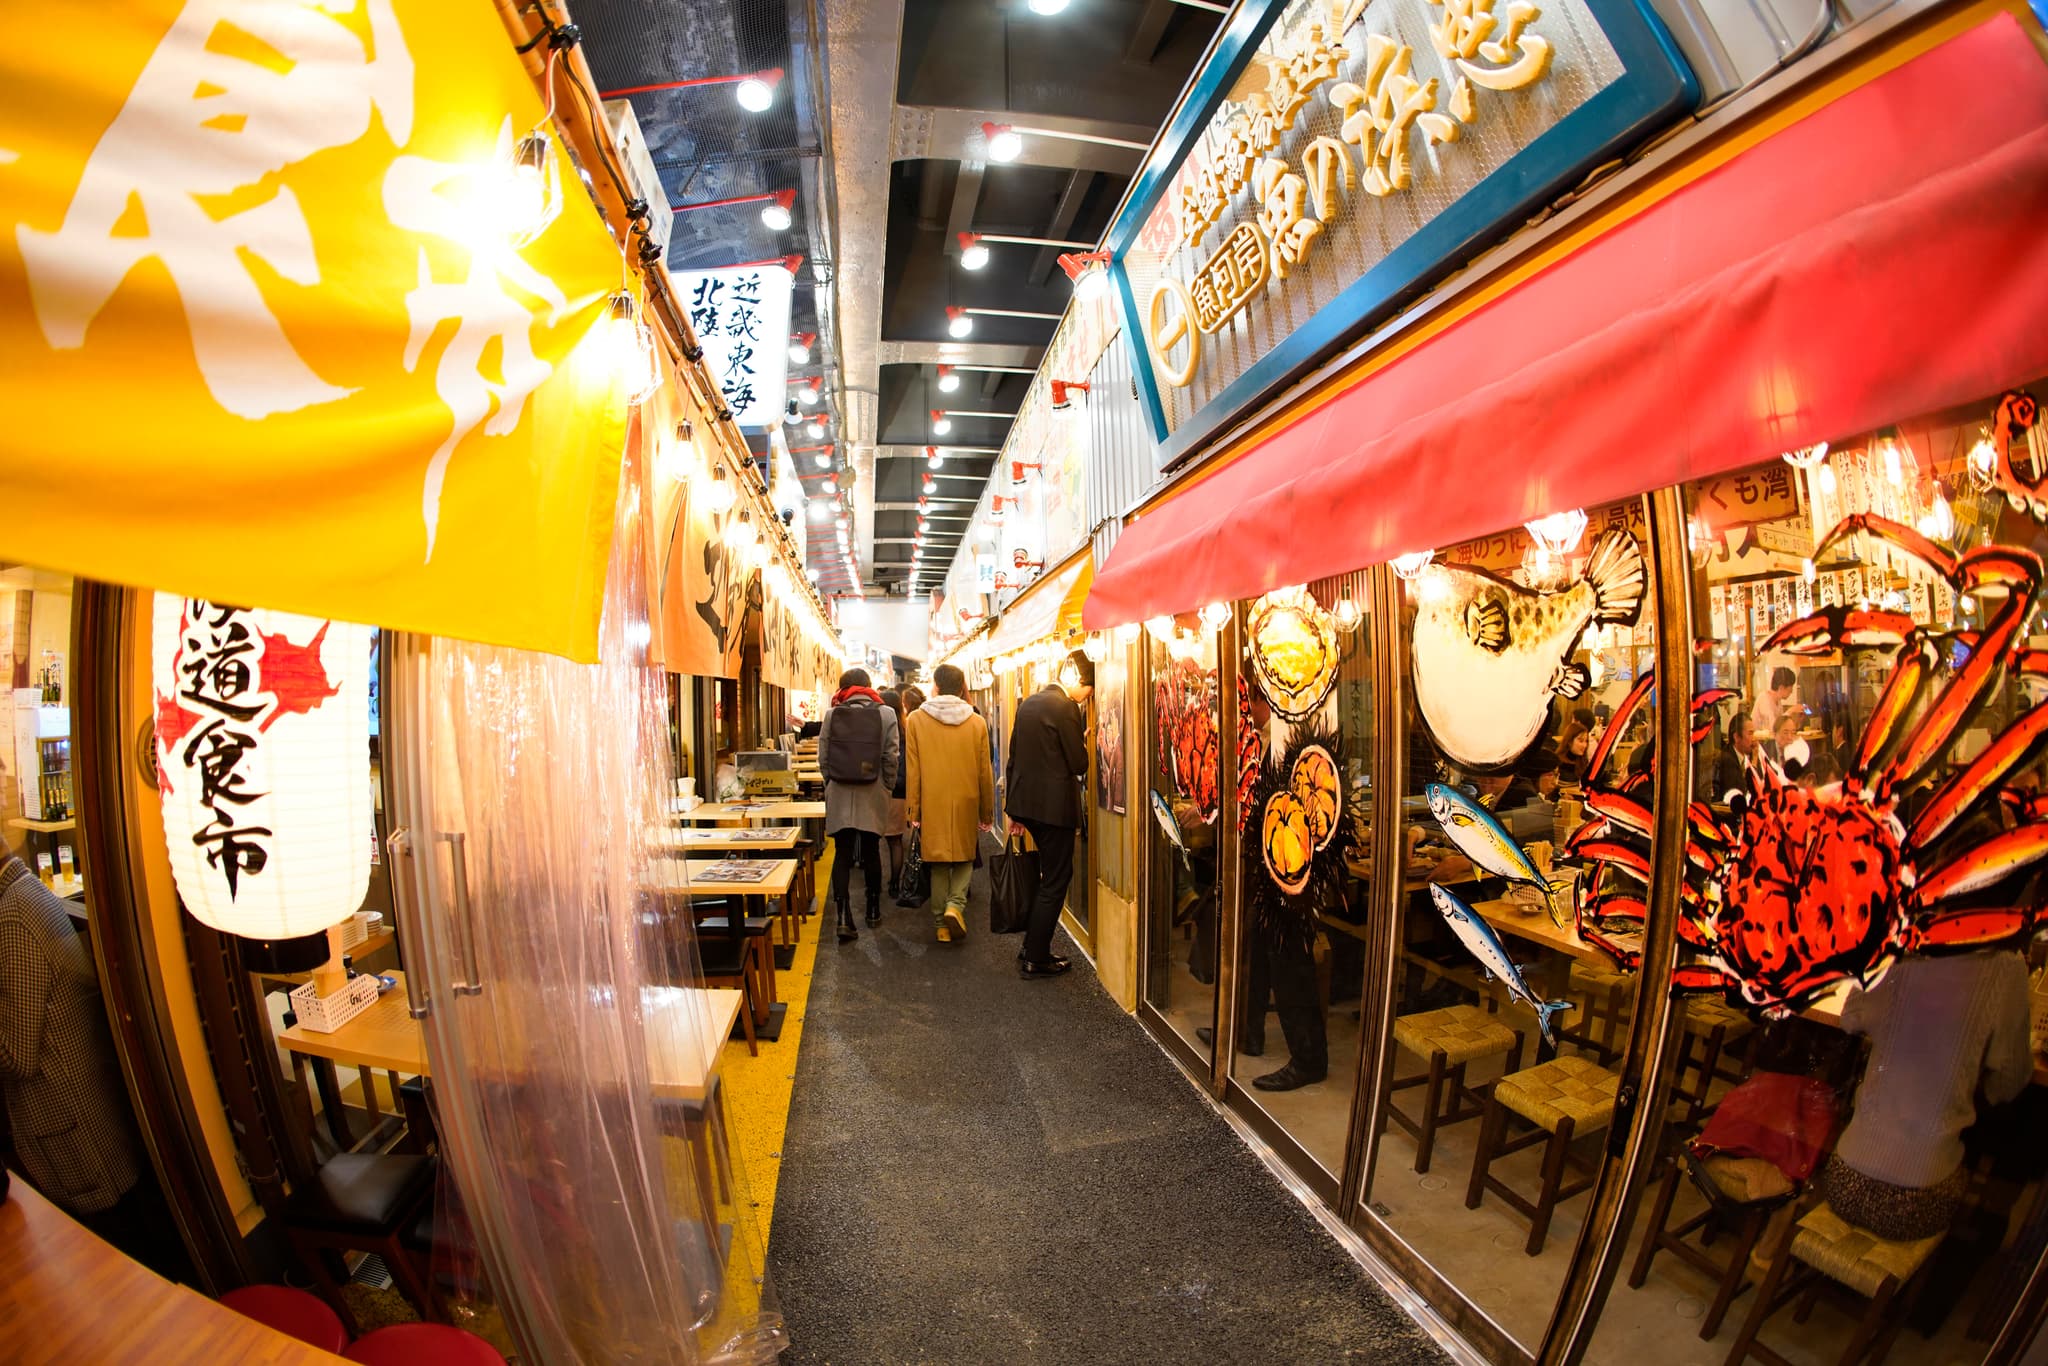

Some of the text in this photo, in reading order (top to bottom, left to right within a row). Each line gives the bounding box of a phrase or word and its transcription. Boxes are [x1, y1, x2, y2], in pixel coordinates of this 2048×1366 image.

[691, 276, 726, 338] 北陸
[1191, 226, 1264, 331] 魚河岸
